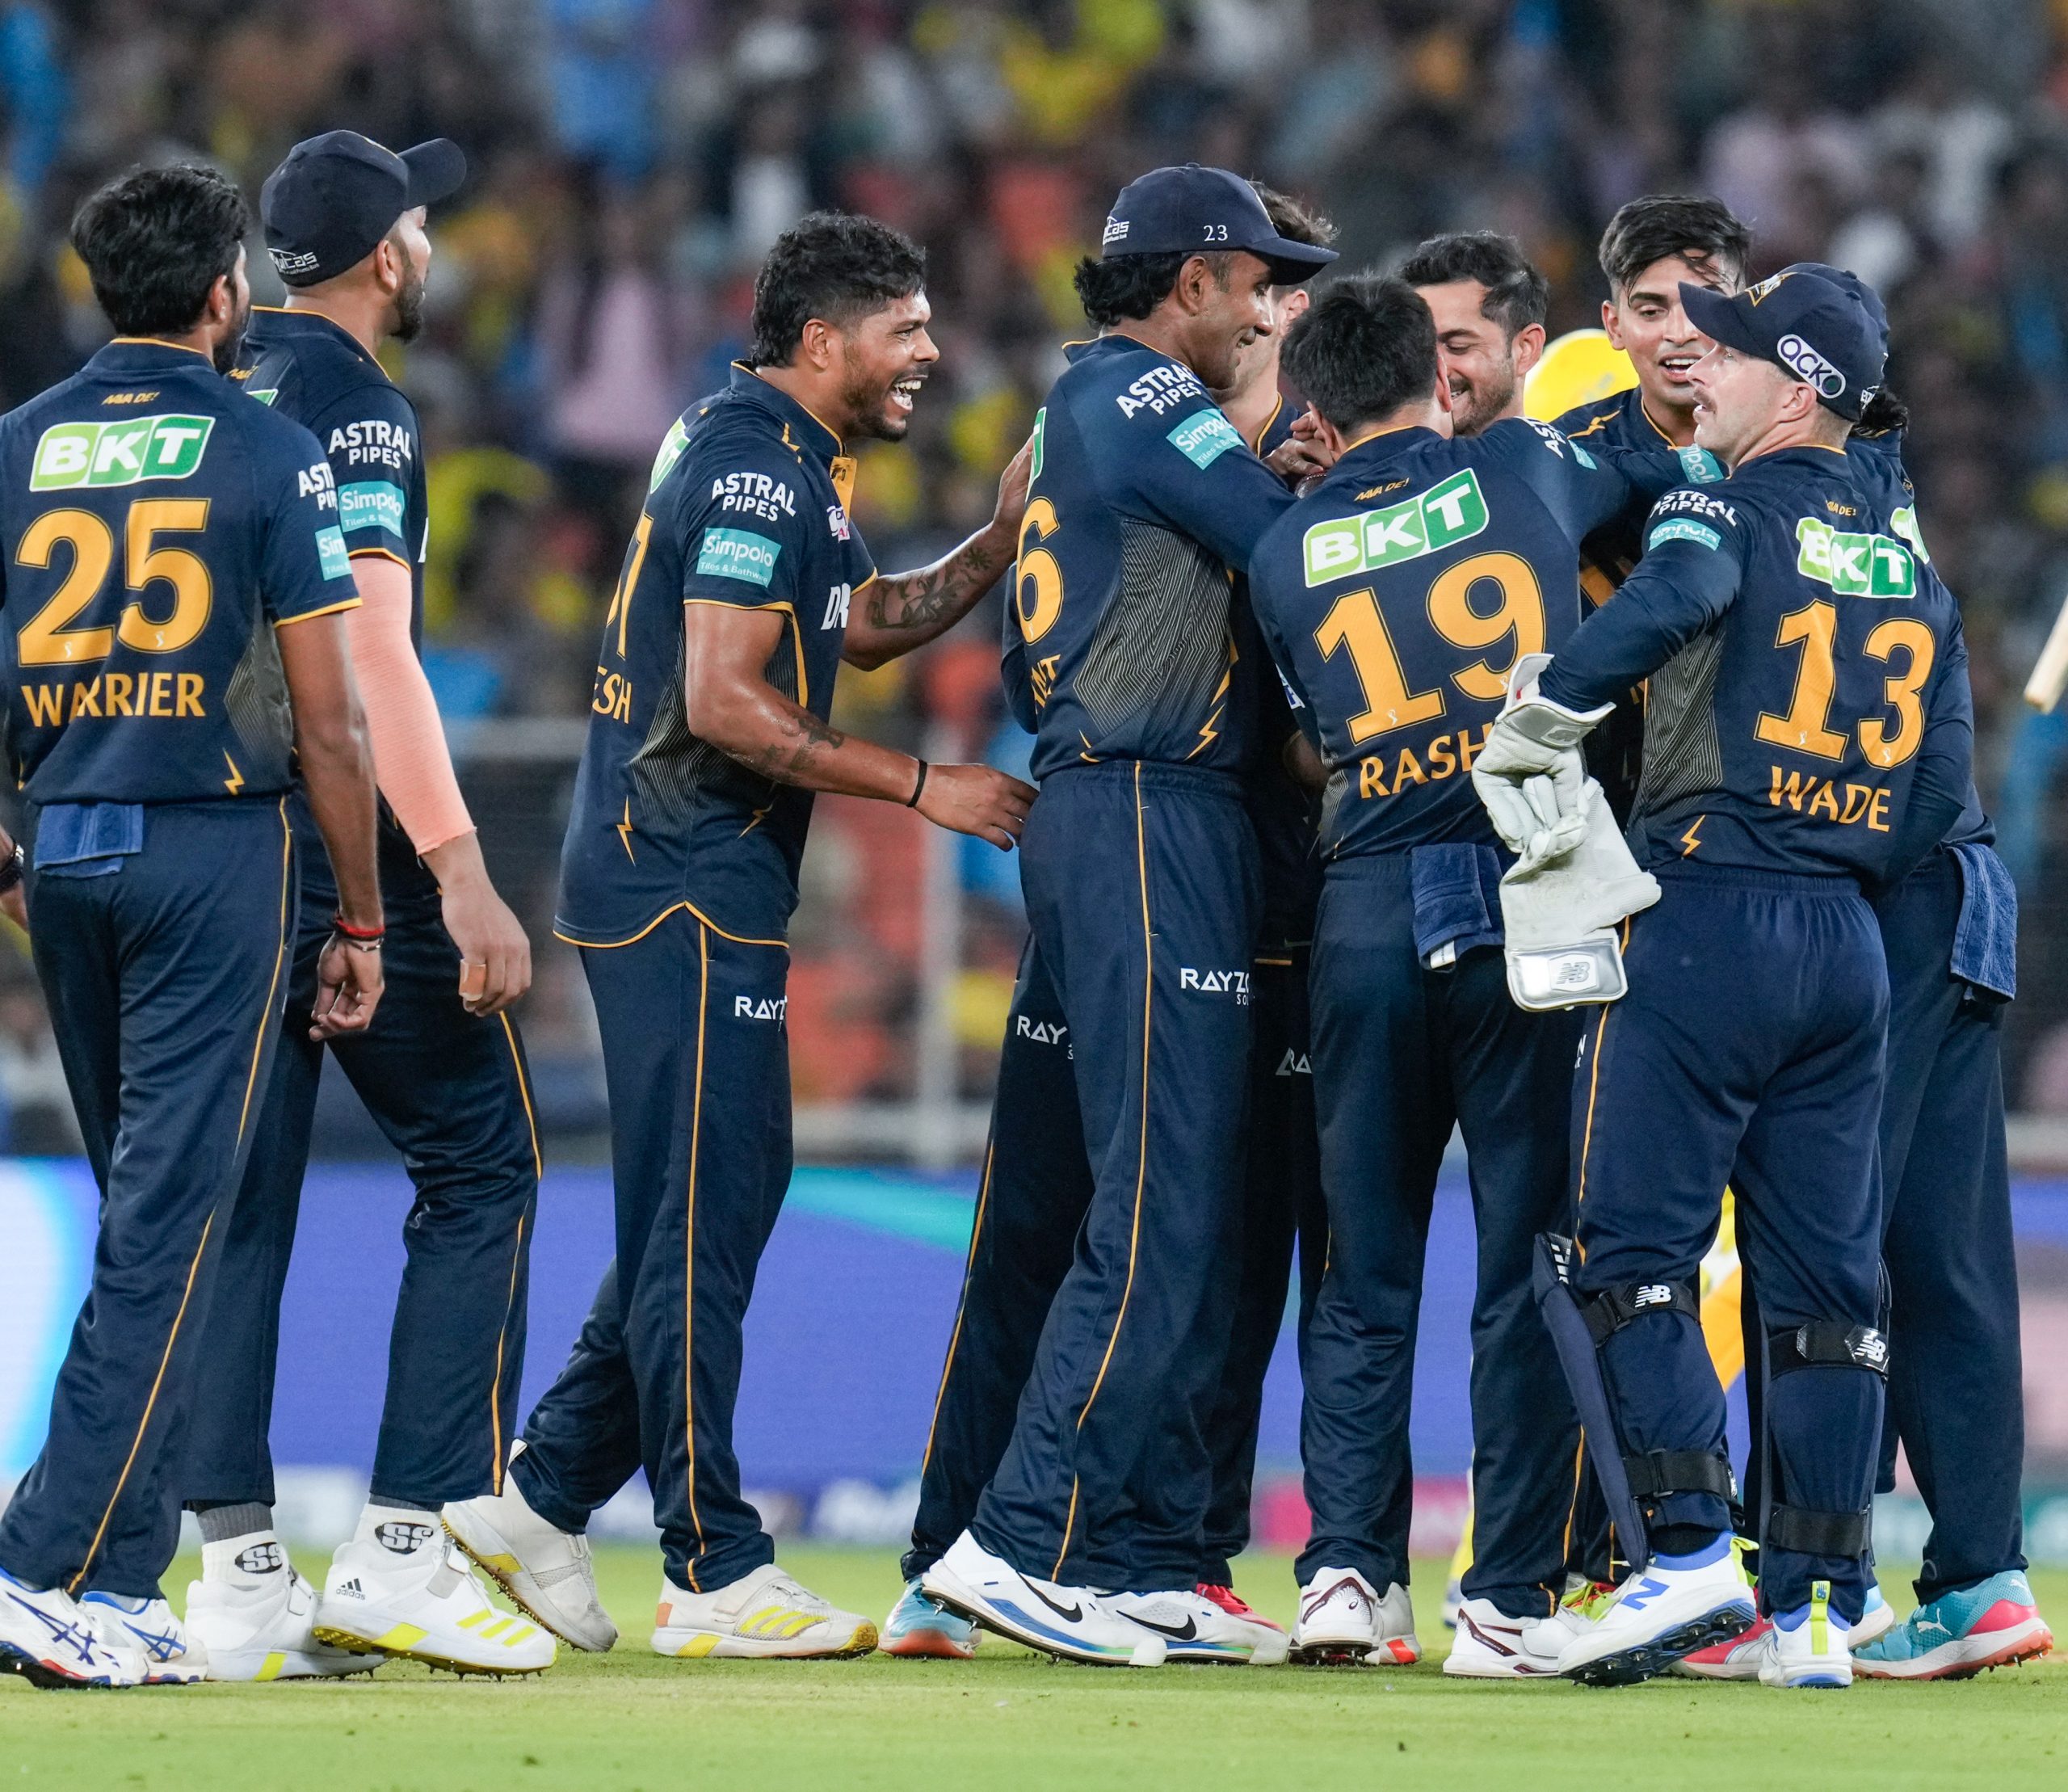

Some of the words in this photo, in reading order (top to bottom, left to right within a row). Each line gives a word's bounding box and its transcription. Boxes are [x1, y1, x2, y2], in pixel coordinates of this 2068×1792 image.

[1203, 225, 1229, 242] 23
[1149, 382, 1202, 415] PIPES
[38, 427, 202, 476] BKT
[328, 420, 412, 461] ASTRAL
[348, 447, 401, 469] PIPES
[712, 472, 797, 517] ASTRAL
[722, 494, 780, 522] PIPES
[1310, 482, 1472, 573] BKT
[702, 535, 773, 567] Simpolo
[1800, 530, 1908, 583] BKT
[14, 498, 213, 668] 25
[1314, 550, 1547, 747] 19
[1753, 598, 1936, 770] 13
[1769, 765, 1892, 833] WADE
[335, 1587, 367, 1601] adidas
